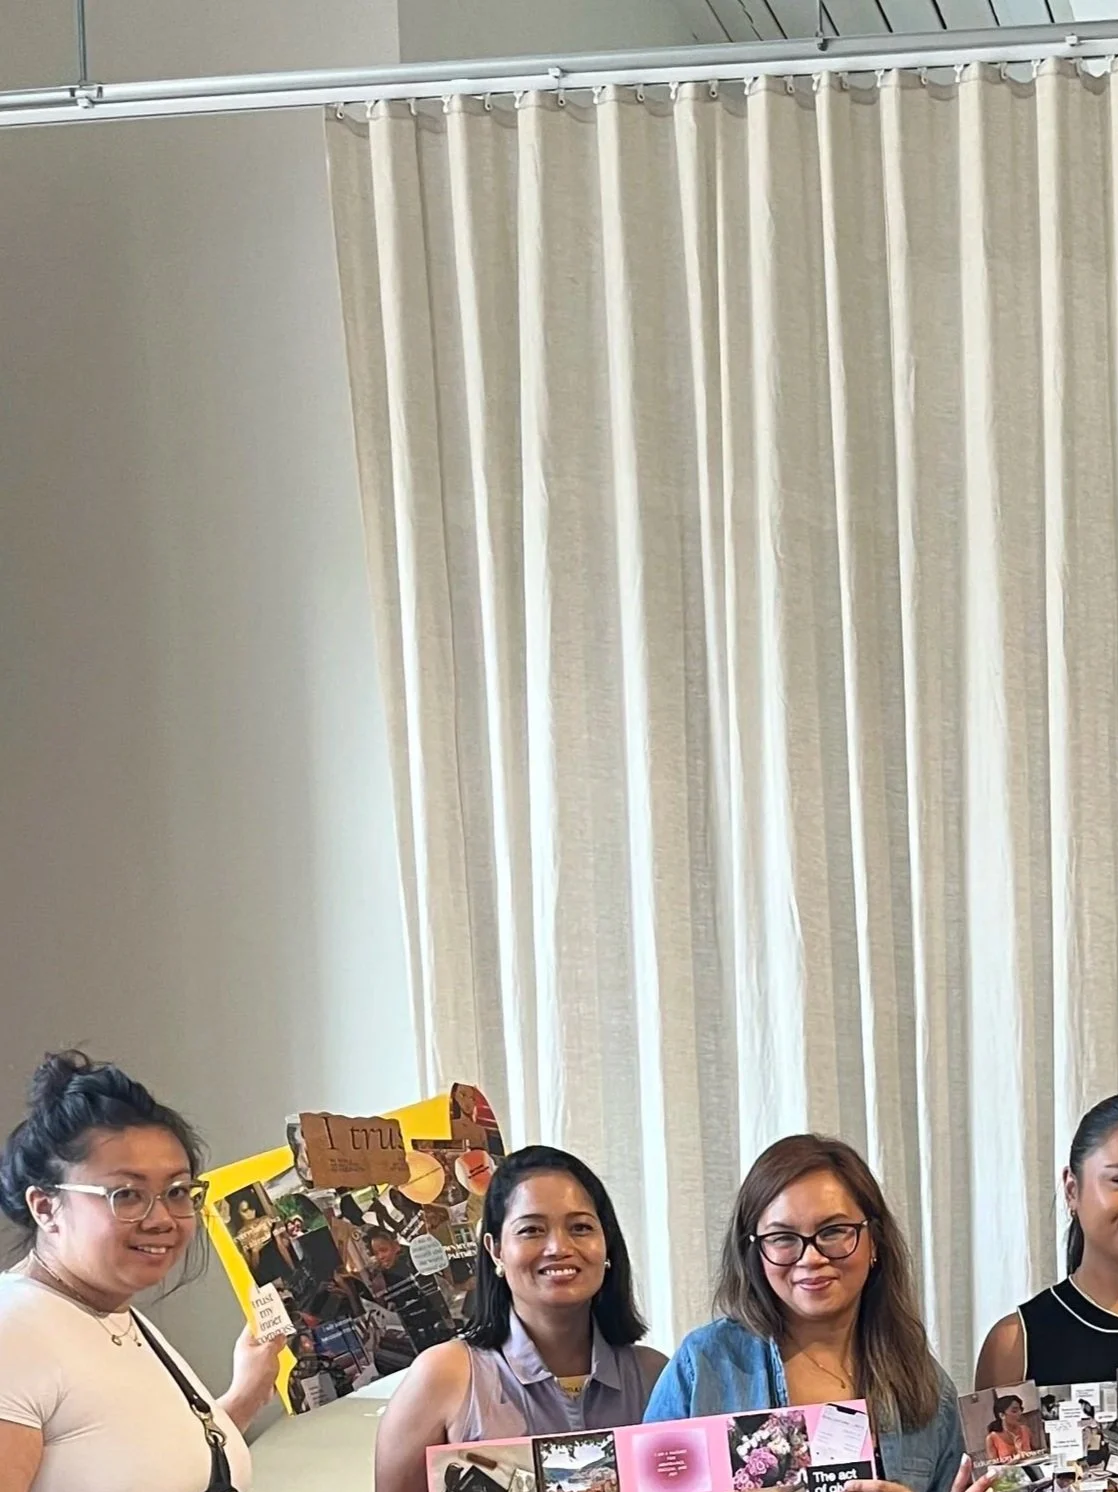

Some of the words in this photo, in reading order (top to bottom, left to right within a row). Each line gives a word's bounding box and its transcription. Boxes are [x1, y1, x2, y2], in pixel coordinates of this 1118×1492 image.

[321, 1116, 339, 1150] I
[812, 1470, 837, 1482] The
[838, 1468, 857, 1480] act
